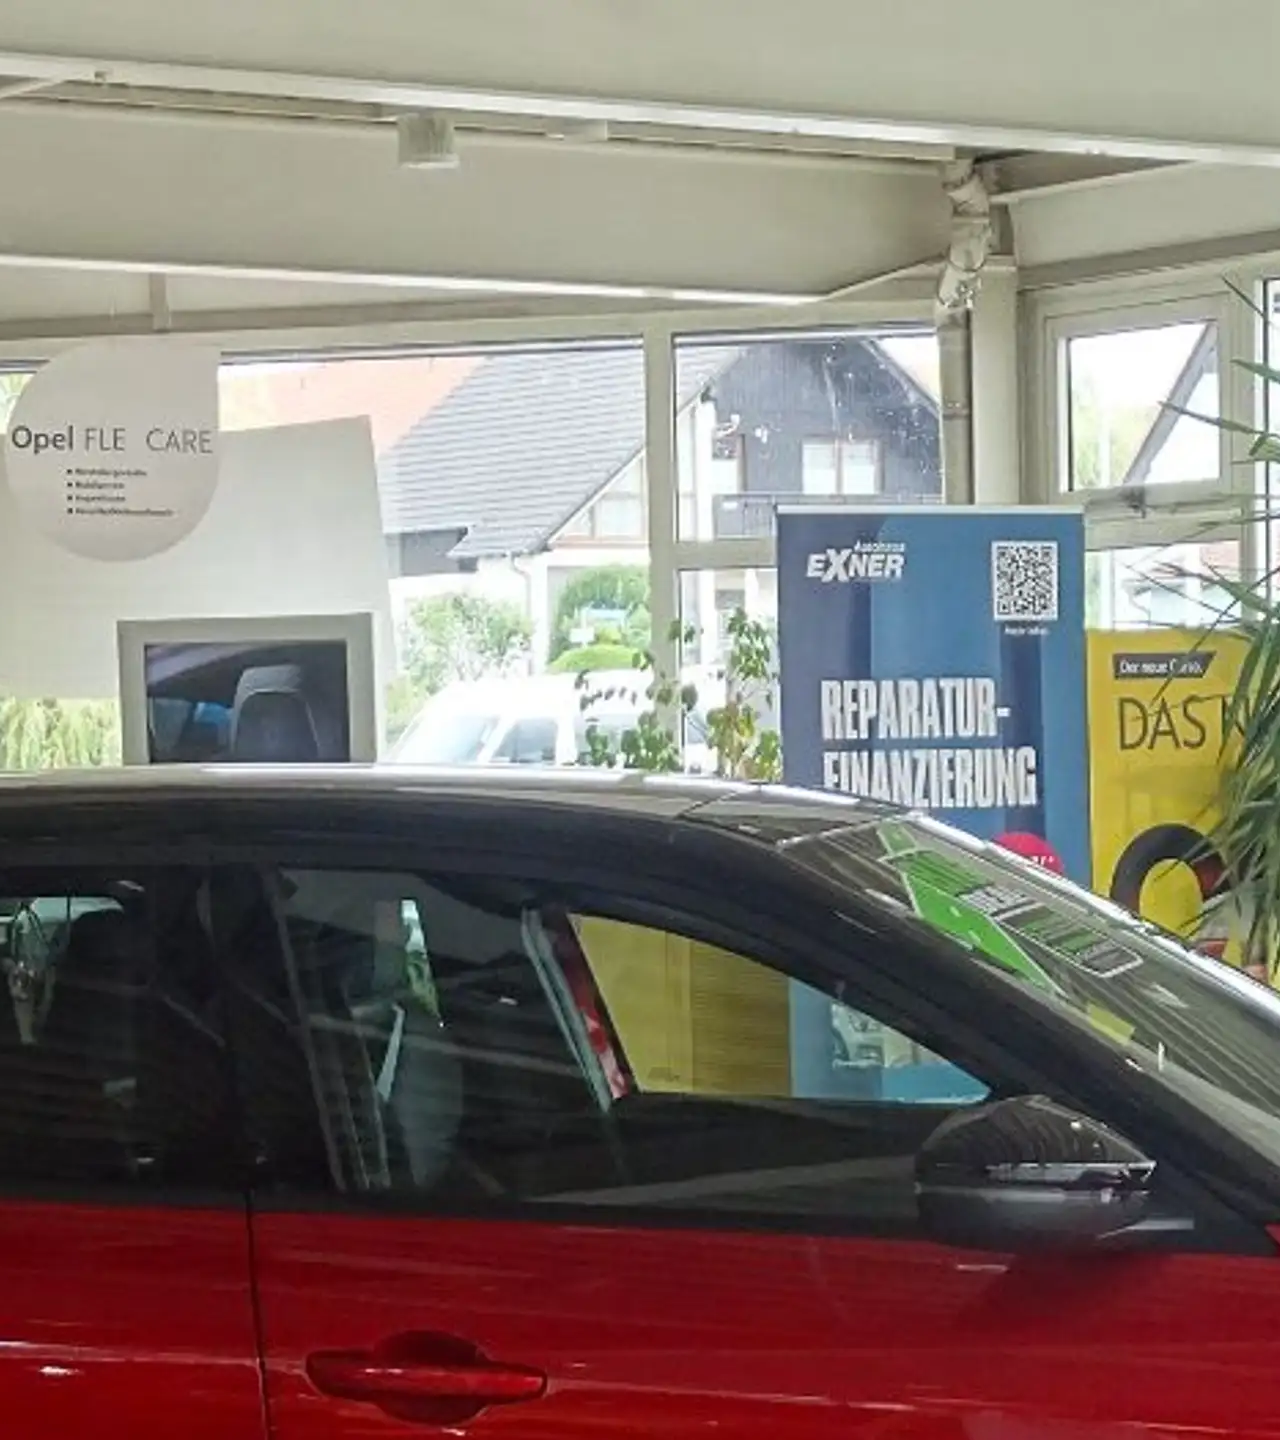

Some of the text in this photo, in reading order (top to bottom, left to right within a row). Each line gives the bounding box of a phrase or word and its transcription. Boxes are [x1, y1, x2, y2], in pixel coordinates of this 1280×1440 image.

[11, 425, 74, 455] Opel
[145, 427, 214, 454] CARE
[806, 548, 905, 583] EXNER
[821, 677, 1012, 740] REPARATUR-
[1118, 694, 1207, 750] DAS
[823, 746, 1038, 808] FINANZIERUNG
